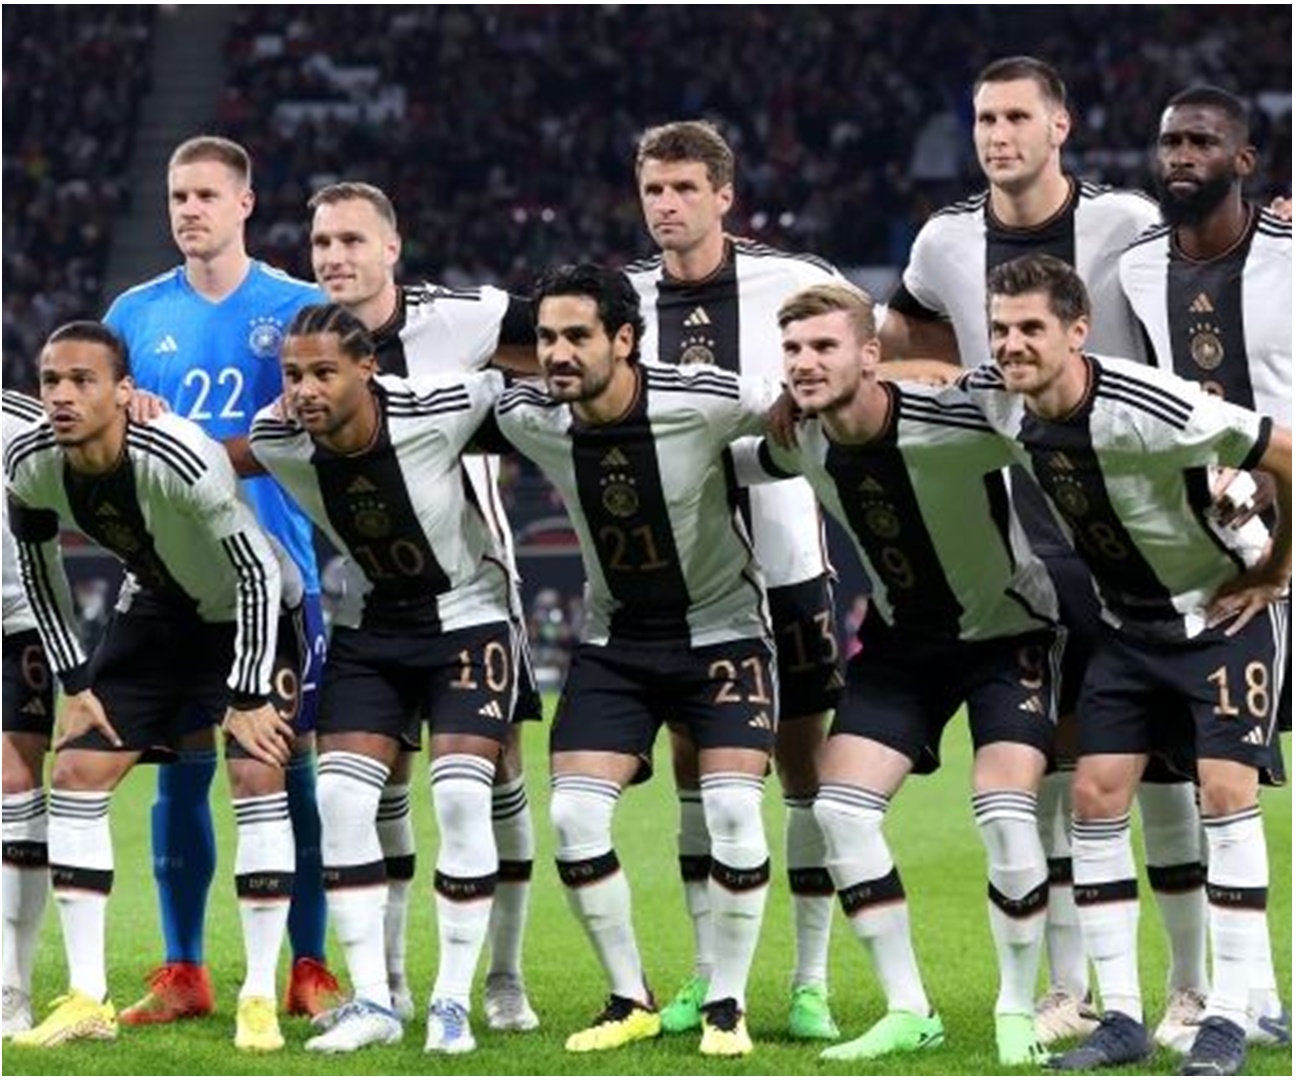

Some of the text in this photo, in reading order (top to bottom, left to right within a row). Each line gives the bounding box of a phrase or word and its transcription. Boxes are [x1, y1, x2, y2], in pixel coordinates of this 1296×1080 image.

[184, 368, 245, 420] 22
[354, 539, 425, 579] 10
[599, 523, 669, 571] 21
[881, 546, 916, 589] 9
[783, 609, 839, 672] 13
[22, 645, 47, 688] 6
[450, 641, 508, 692] 10
[708, 656, 771, 705] 21
[1207, 661, 1270, 718] 18
